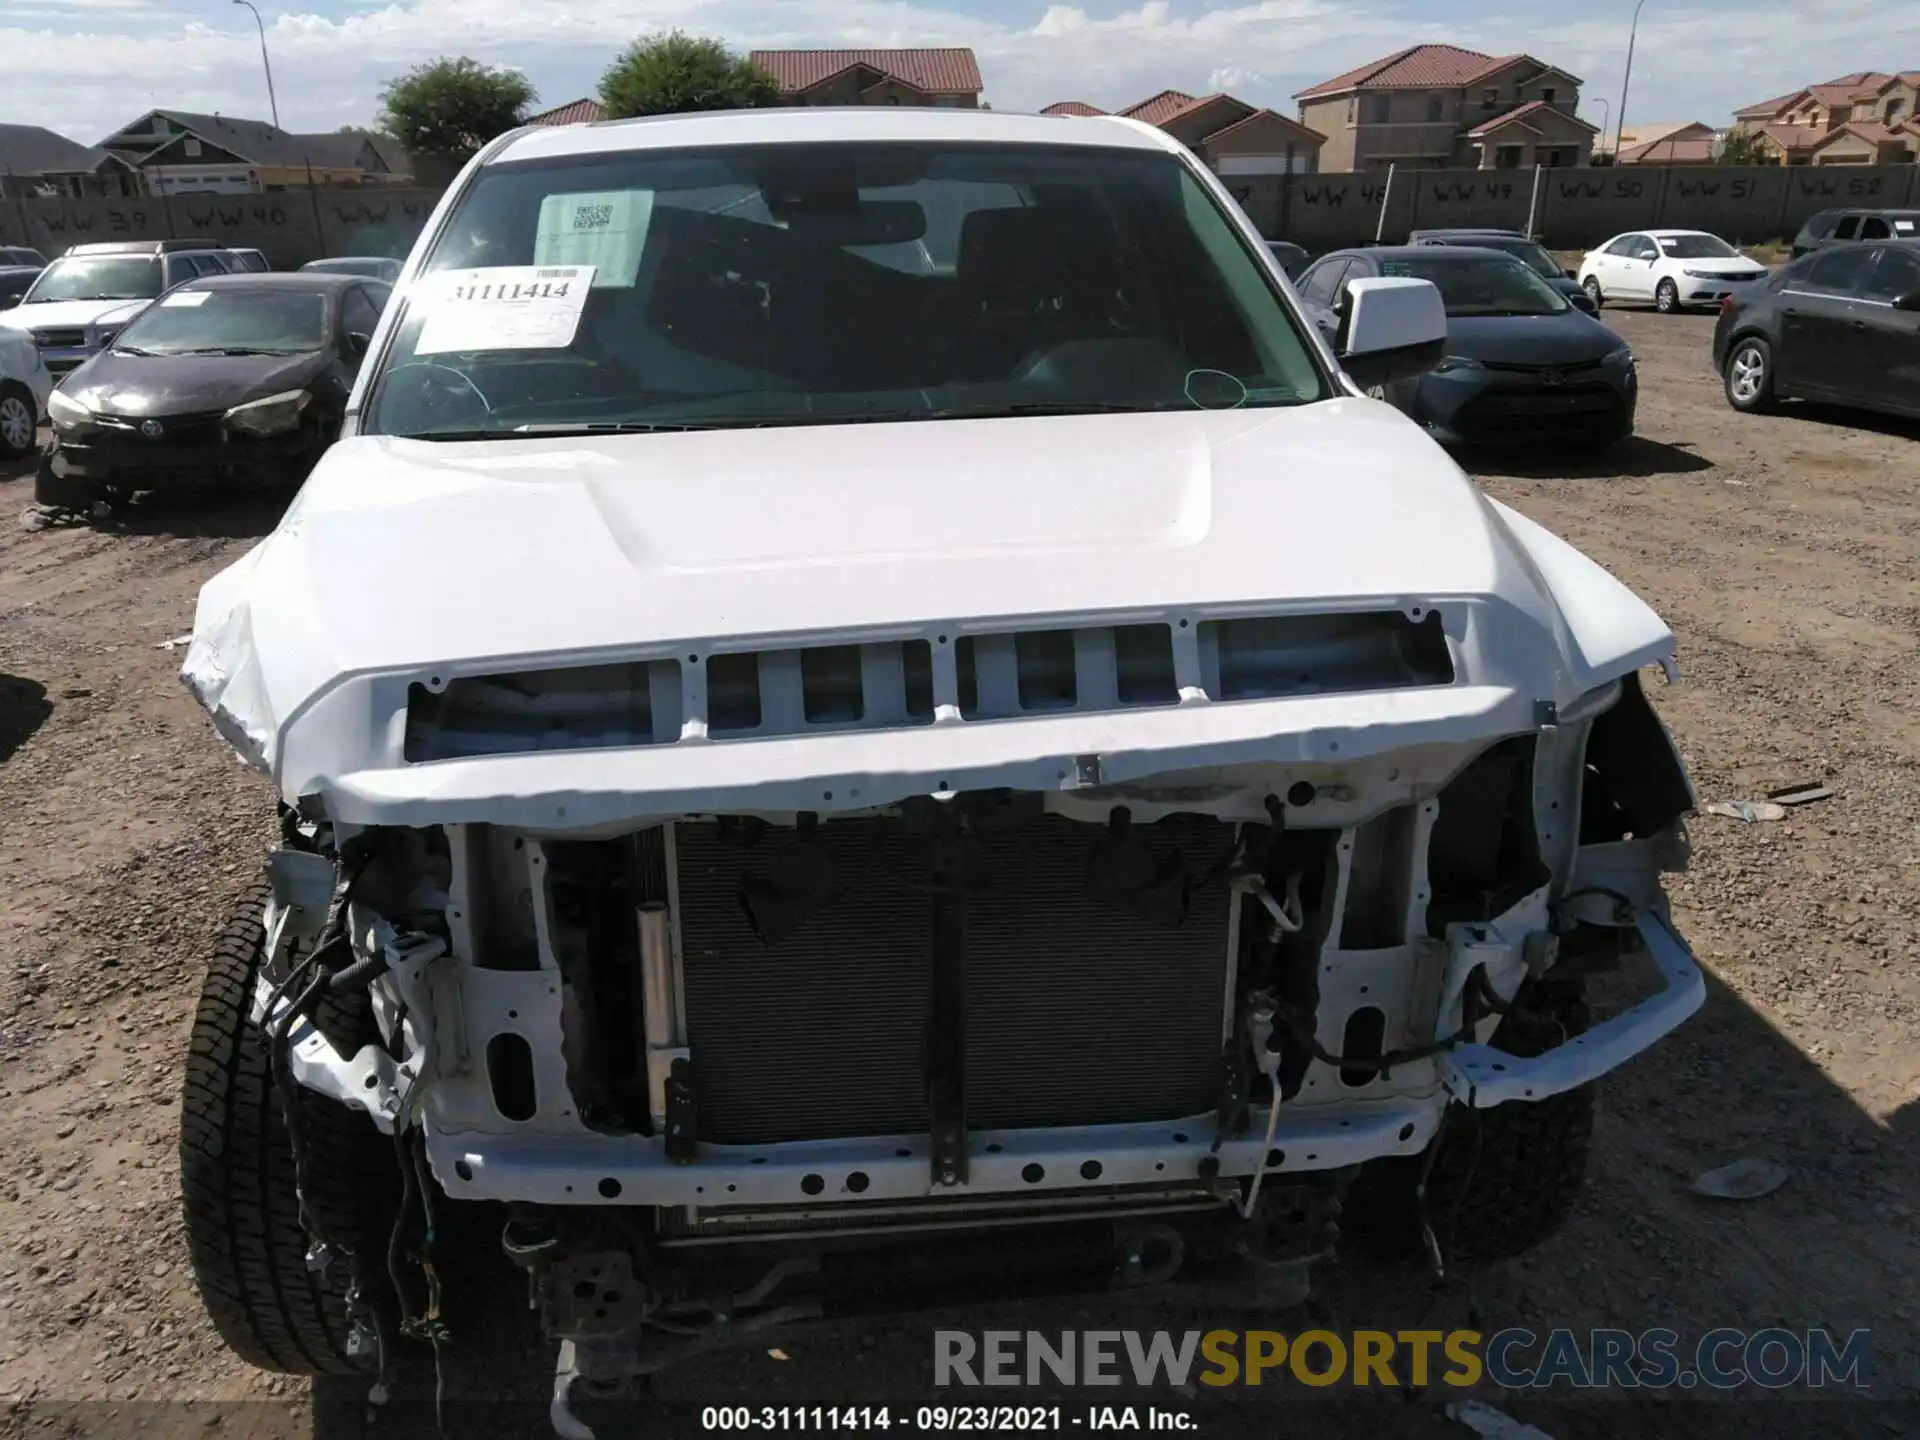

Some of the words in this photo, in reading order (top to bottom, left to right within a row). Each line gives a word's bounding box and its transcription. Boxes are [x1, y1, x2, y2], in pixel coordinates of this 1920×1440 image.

[1614, 181, 1643, 198] 50
[1730, 180, 1757, 198] 51
[1848, 178, 1881, 195] 52
[109, 211, 147, 232] 39
[254, 207, 287, 226] 40
